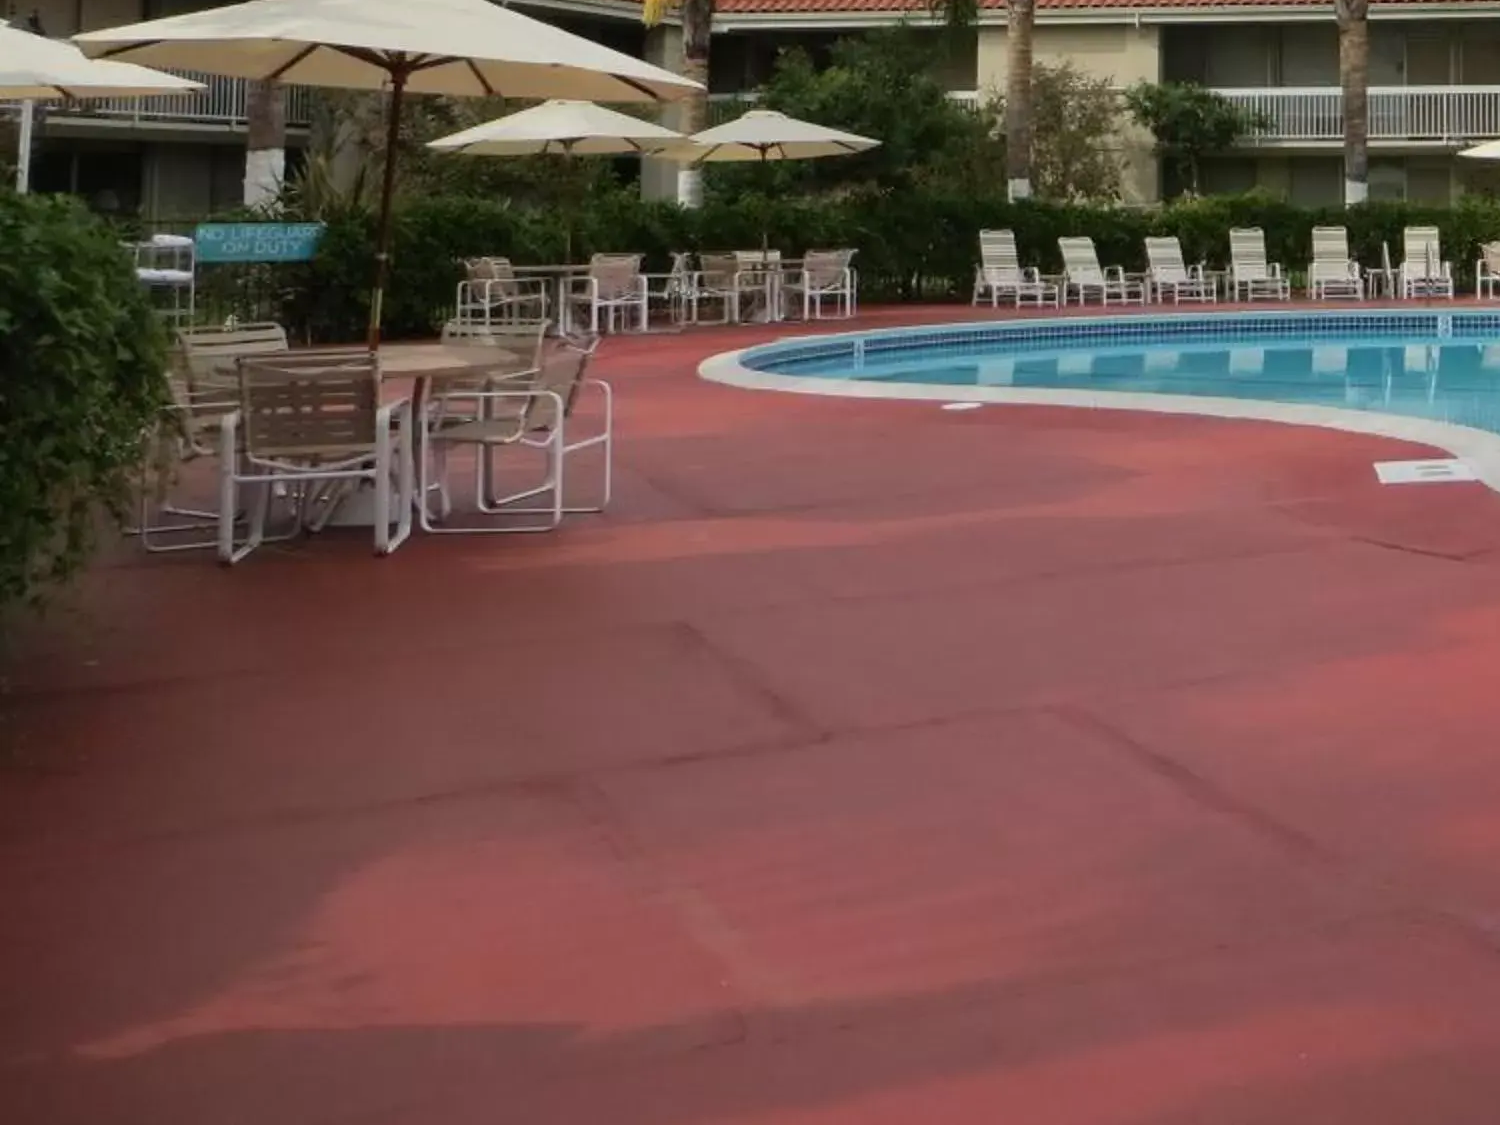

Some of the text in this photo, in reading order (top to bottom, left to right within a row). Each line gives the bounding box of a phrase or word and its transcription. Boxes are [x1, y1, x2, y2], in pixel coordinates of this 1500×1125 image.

[197, 226, 225, 241] NO
[222, 239, 303, 254] ON DUTY
